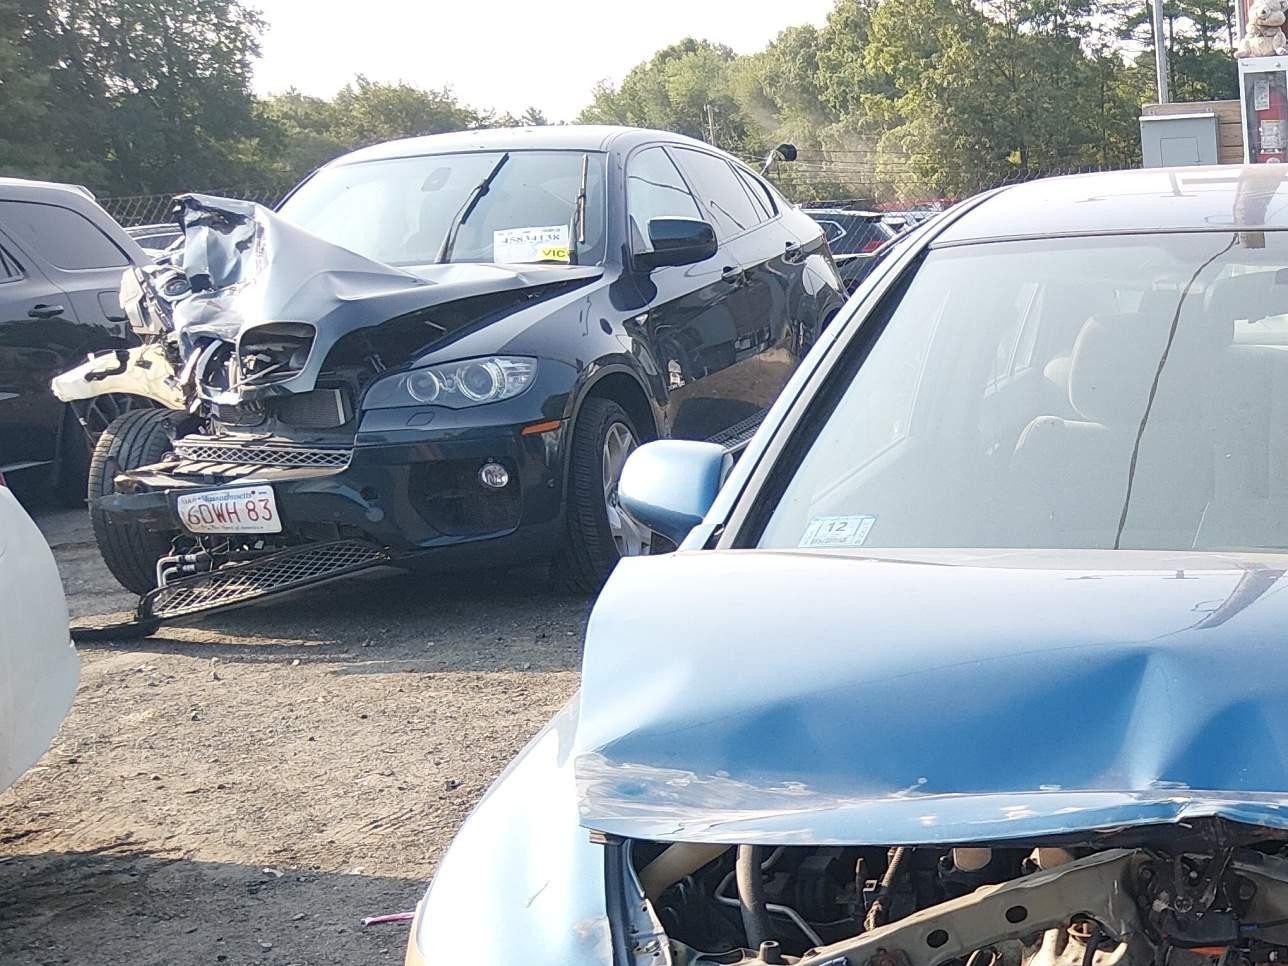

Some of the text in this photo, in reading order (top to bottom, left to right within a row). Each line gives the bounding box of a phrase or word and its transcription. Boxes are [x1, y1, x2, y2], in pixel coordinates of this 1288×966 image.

[543, 250, 566, 258] VIC
[246, 499, 273, 521] 83
[828, 522, 848, 532] 12
